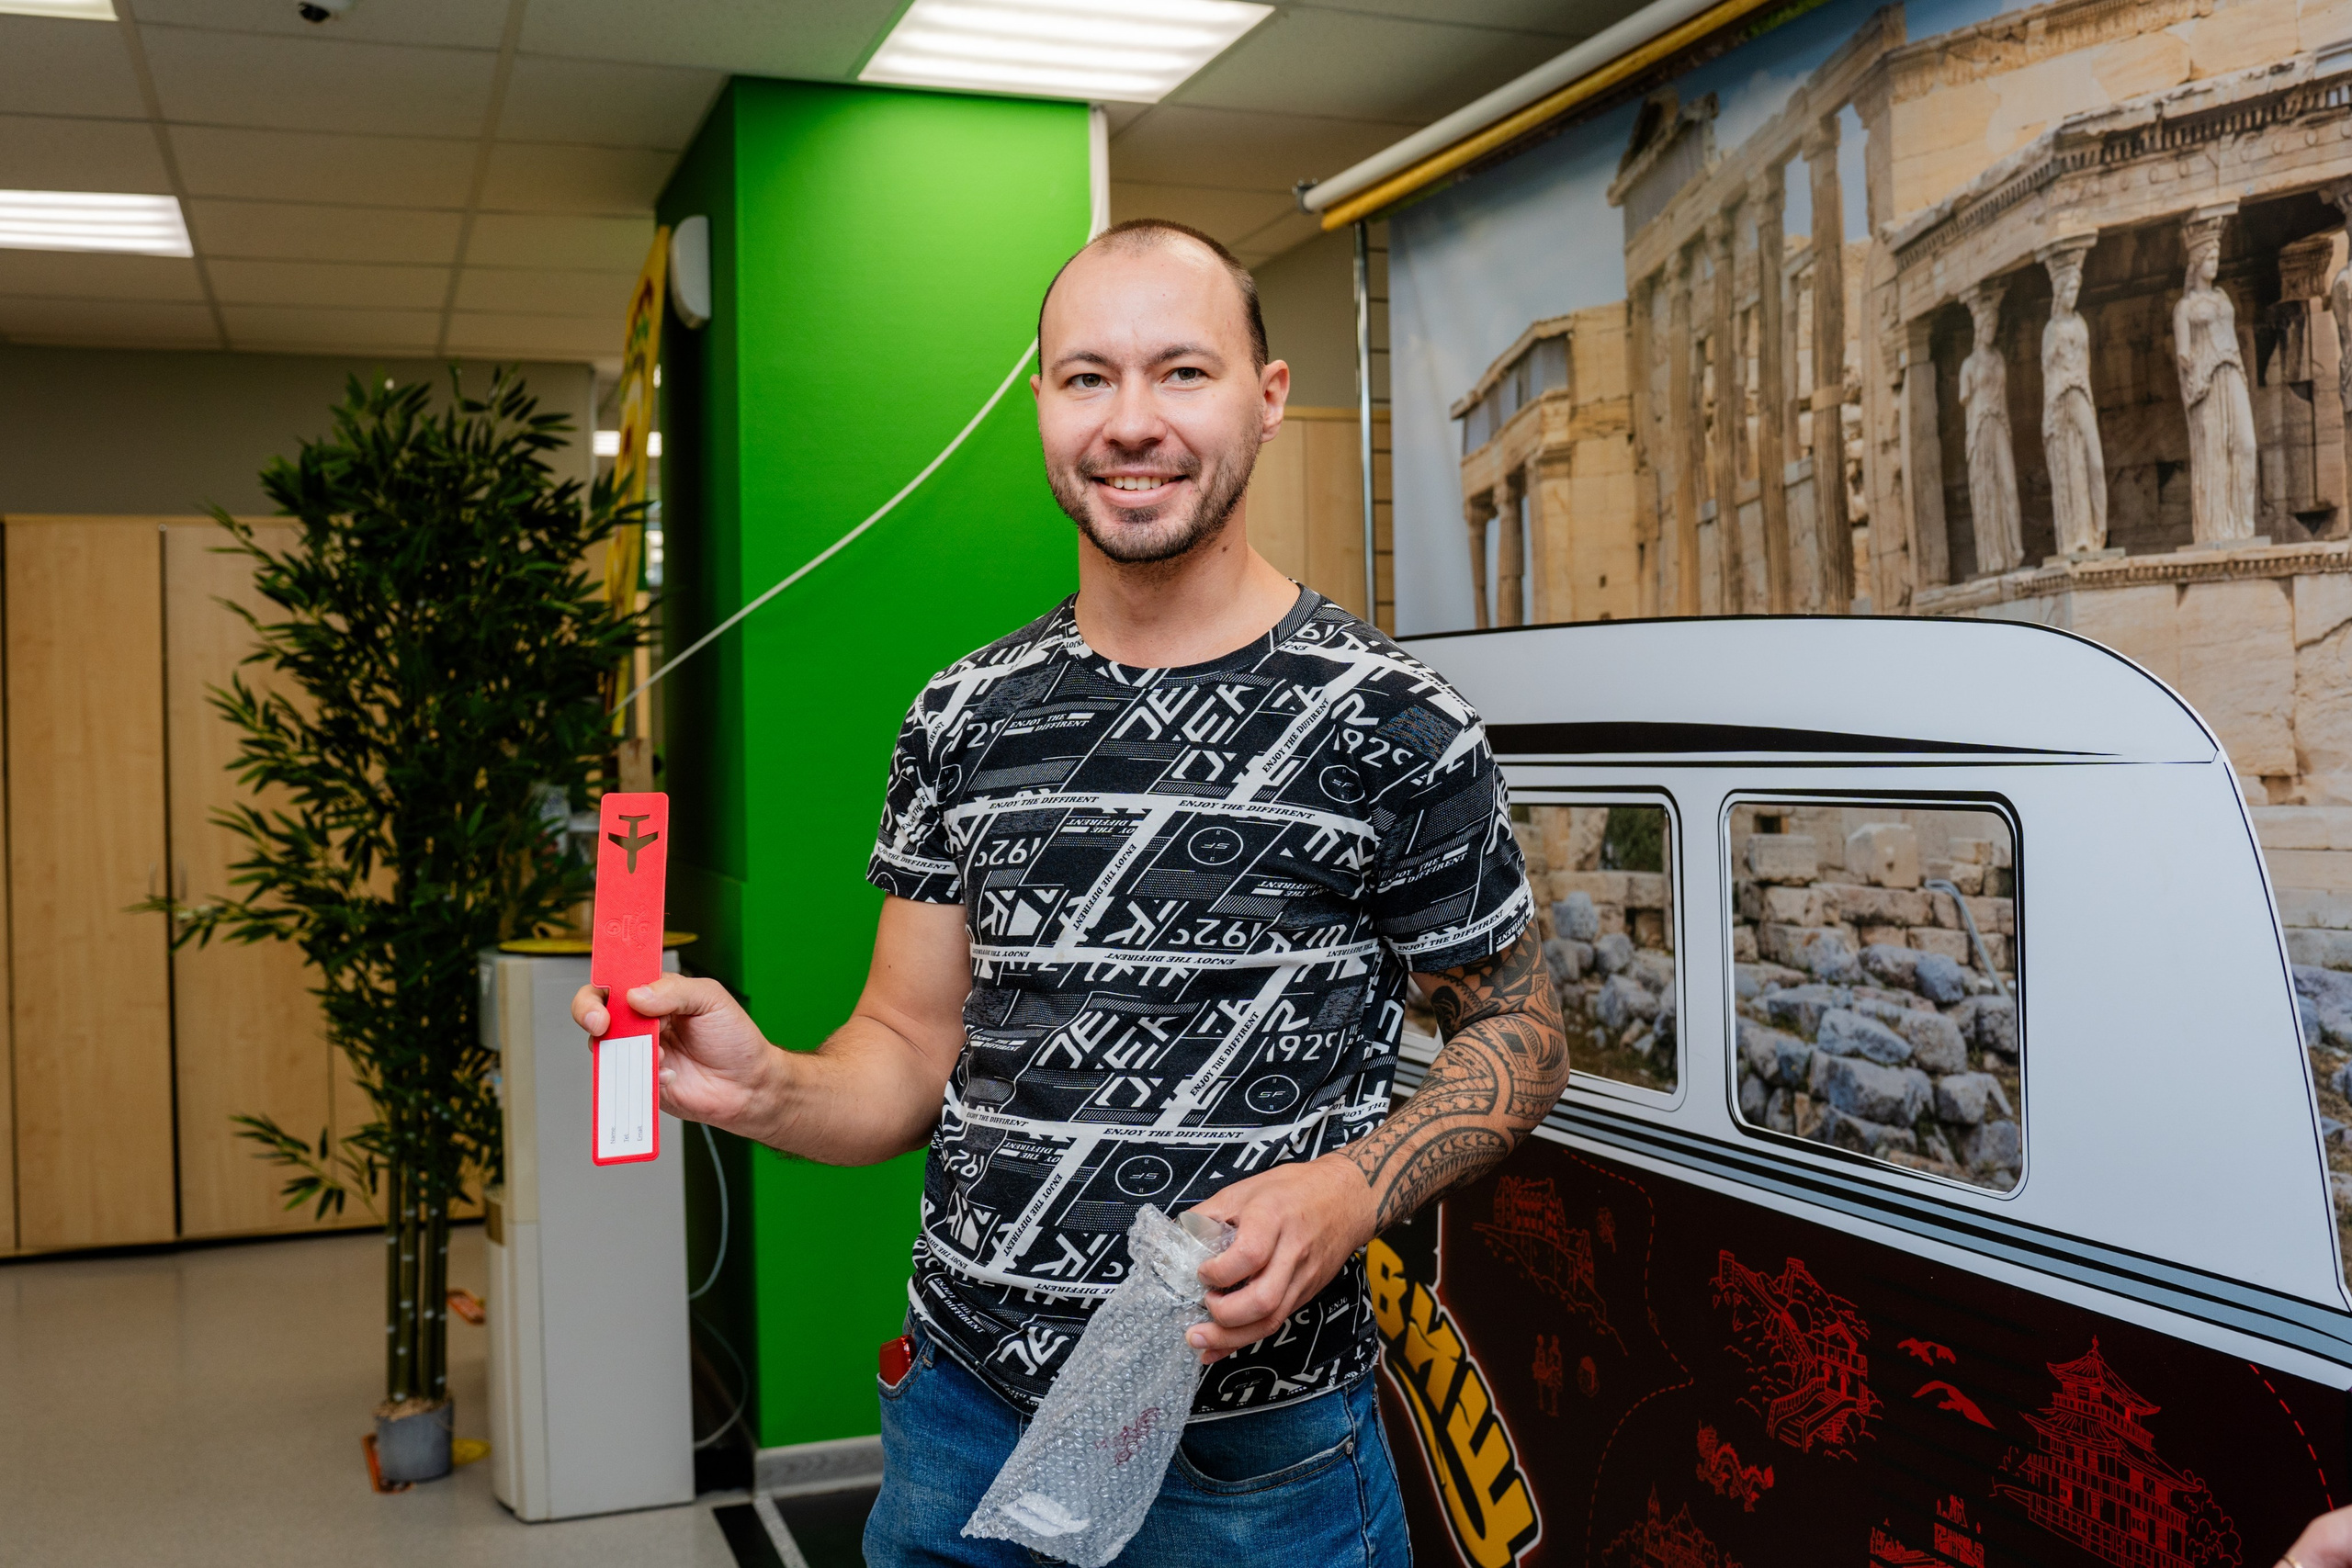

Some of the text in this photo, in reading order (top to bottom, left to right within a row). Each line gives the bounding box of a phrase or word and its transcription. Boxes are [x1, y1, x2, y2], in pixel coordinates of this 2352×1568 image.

[1009, 713, 1068, 728] ENJOY THE
[1262, 749, 1286, 773] ENJOY
[1283, 733, 1299, 750] THE
[989, 795, 1100, 810] ENJOY THE DIFFIRENT
[1178, 799, 1316, 819] ENJOY THE DIFFIRENT
[1072, 843, 1136, 931] ENJOY THE DIFFIRENT
[1397, 909, 1504, 952] ENJOY THE DIFFIRENT
[1001, 950, 1031, 958] ENJOY
[1104, 953, 1237, 965] ENJOY THE DIFFIRENT
[1189, 1010, 1260, 1097] ENJOY THE DIFFIRENT
[1102, 1127, 1244, 1139] ENJOY THE DIFFIRENT
[1020, 1151, 1040, 1160] THE
[1002, 1172, 1063, 1258] ENJOY THE DIFFIRENT
[1035, 1283, 1098, 1295] DIFFIRENT
